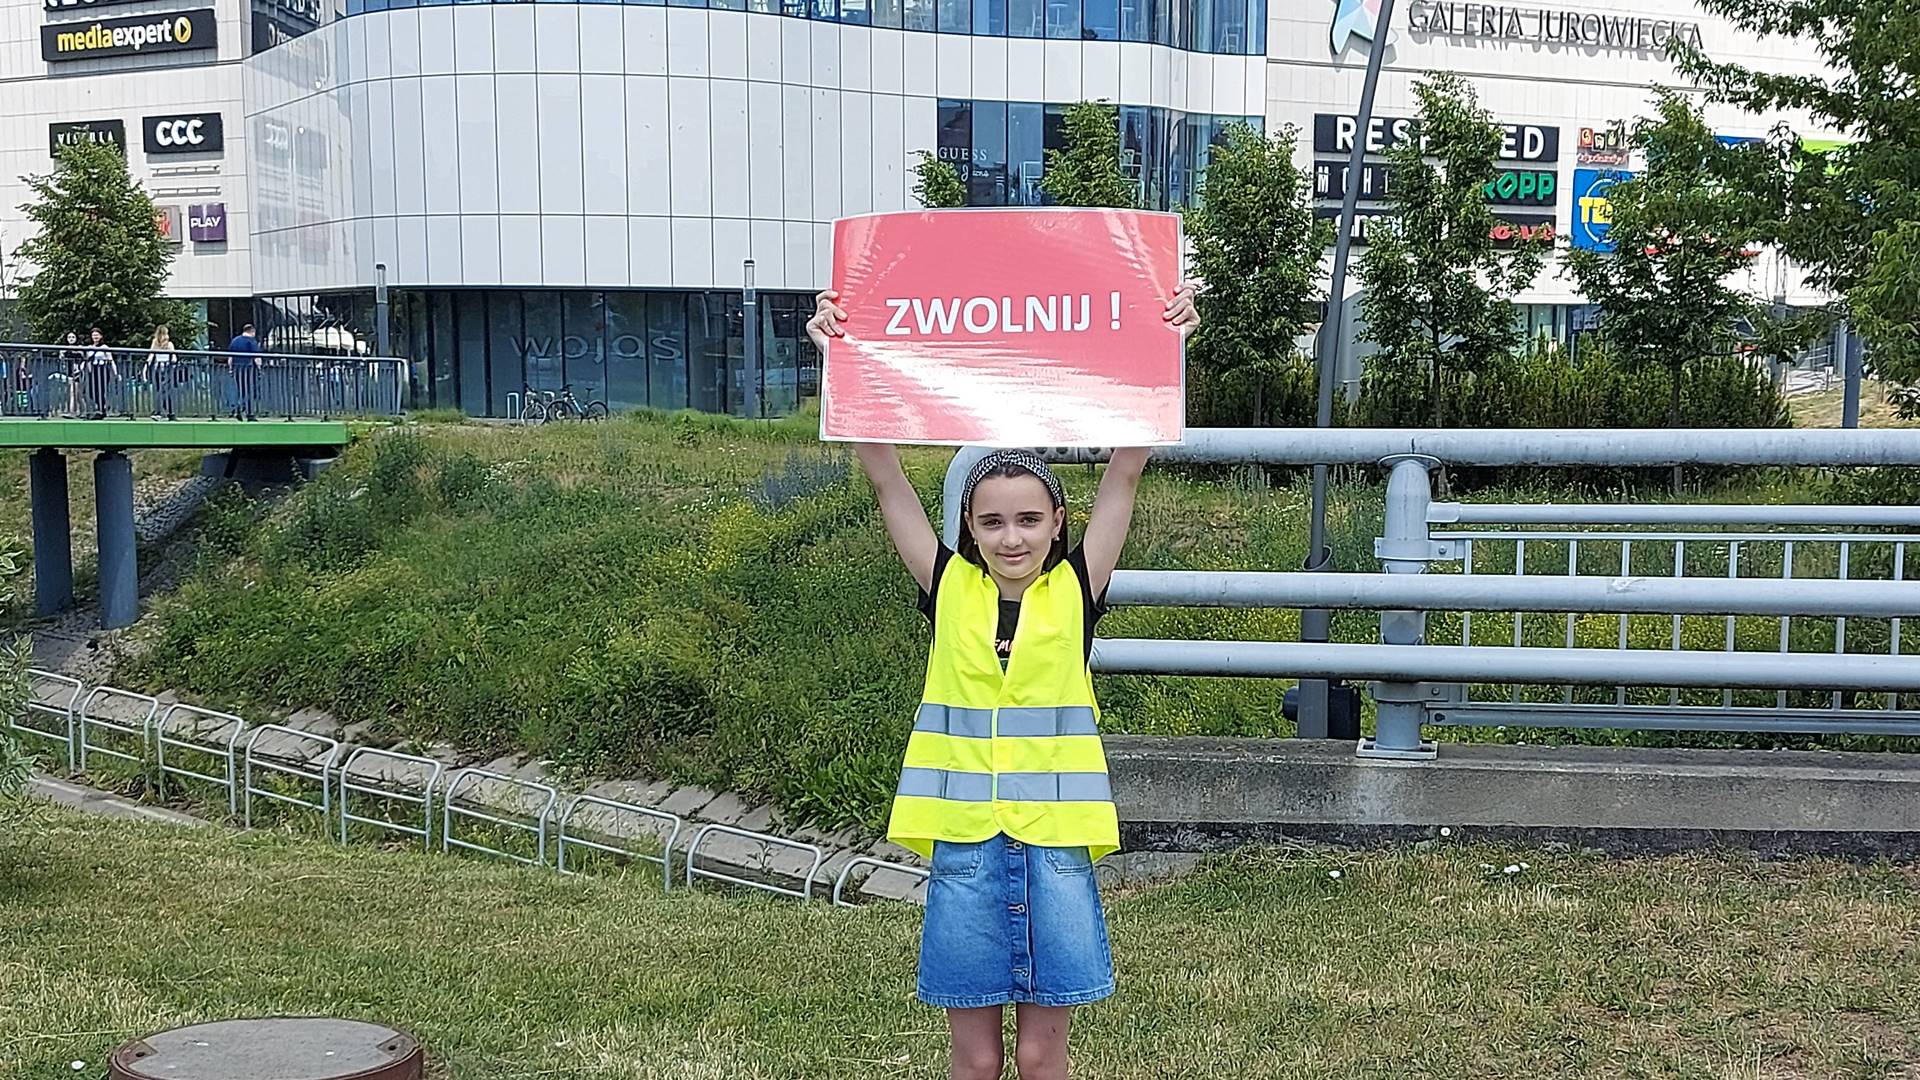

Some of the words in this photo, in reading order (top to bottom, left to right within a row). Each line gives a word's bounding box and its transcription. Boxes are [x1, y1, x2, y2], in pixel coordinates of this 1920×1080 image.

[56, 18, 172, 52] mediaexpert
[1408, 0, 1523, 36] GALERIA
[1523, 9, 1704, 50] JUROWIECKA
[155, 119, 205, 146] CCC
[1335, 115, 1545, 159] RESED
[938, 146, 988, 161] GUESS
[190, 216, 222, 229] PLAY
[884, 294, 1091, 336] ZWOLNIJ
